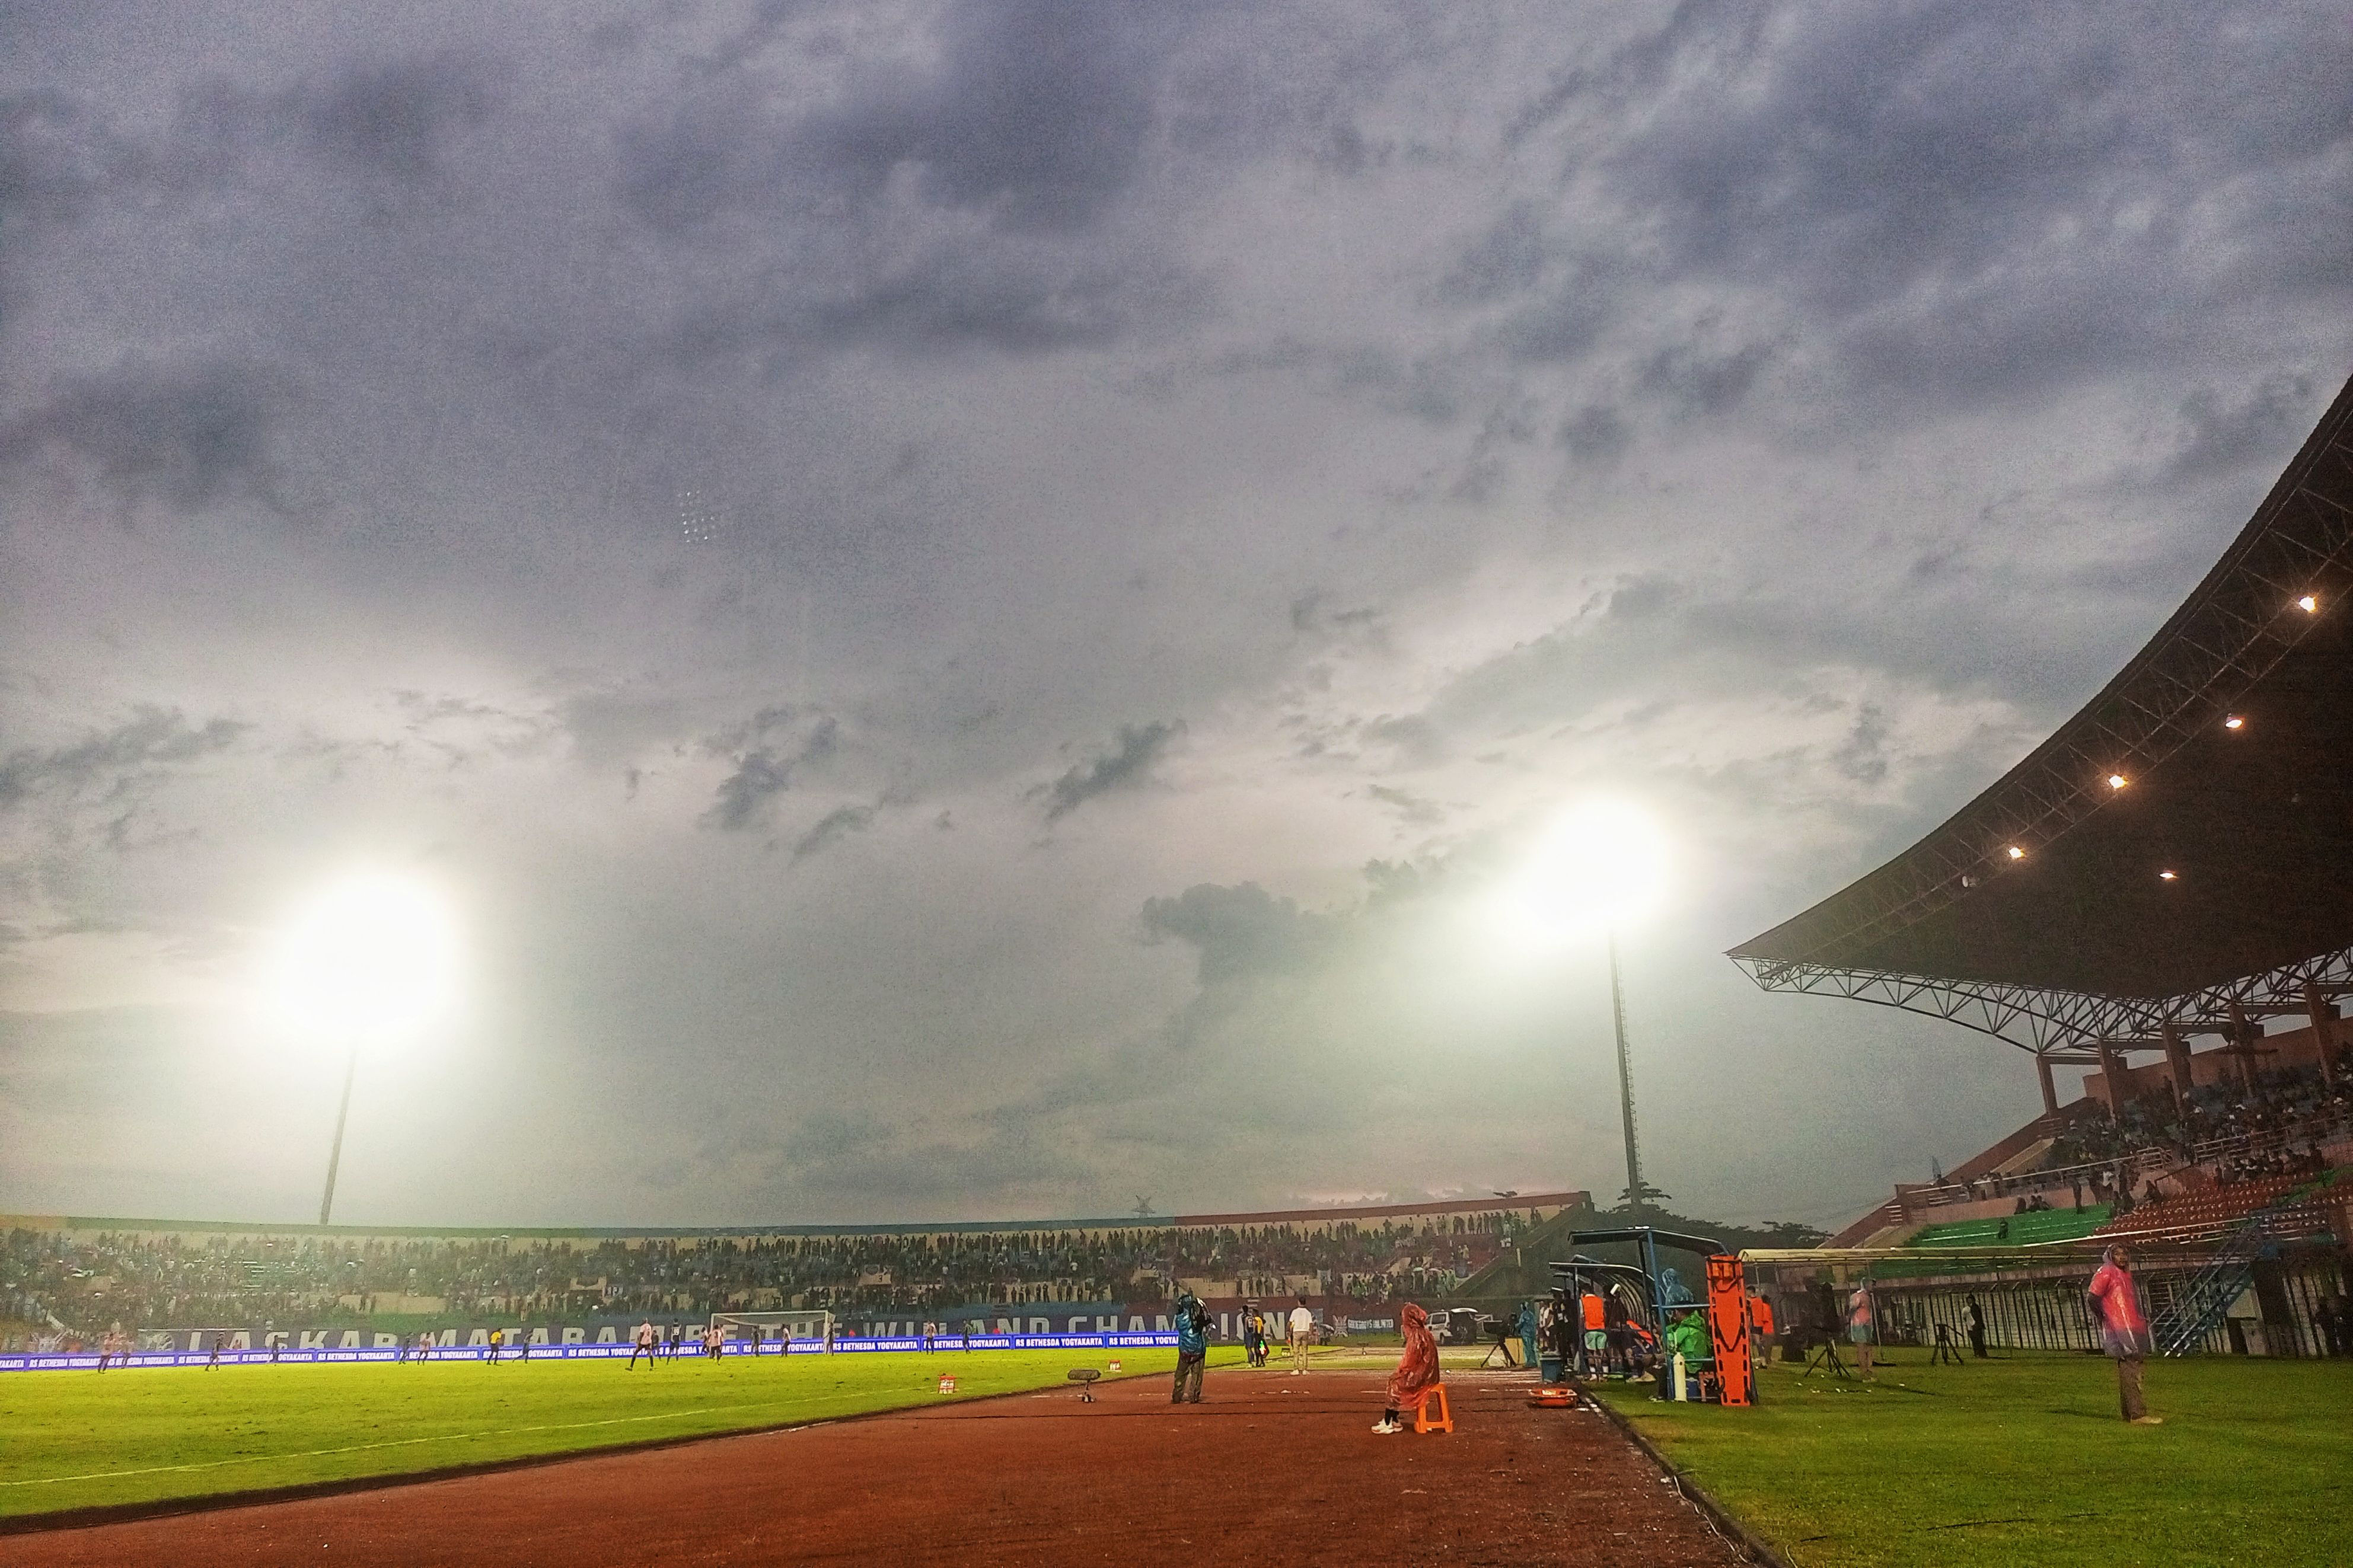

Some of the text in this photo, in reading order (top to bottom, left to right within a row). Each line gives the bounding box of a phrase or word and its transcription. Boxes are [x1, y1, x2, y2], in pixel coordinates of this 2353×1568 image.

[968, 1339, 1009, 1348] YOGYAKARTA
[1026, 1338, 1060, 1347] BETHESDA
[1061, 1337, 1103, 1346] YOGYAKARTA
[1120, 1337, 1154, 1345] BETHESDA
[843, 1342, 876, 1351] BETHESDA
[876, 1341, 918, 1350] YOGYAKARTA
[278, 1353, 313, 1361] OGYAKARTA
[358, 1352, 395, 1360] YOGYAKARTA
[441, 1351, 478, 1359] YOGYAKARTA
[528, 1349, 563, 1358] OGYAKARTA
[568, 1349, 577, 1357] RS
[578, 1348, 610, 1357] BETHESDA
